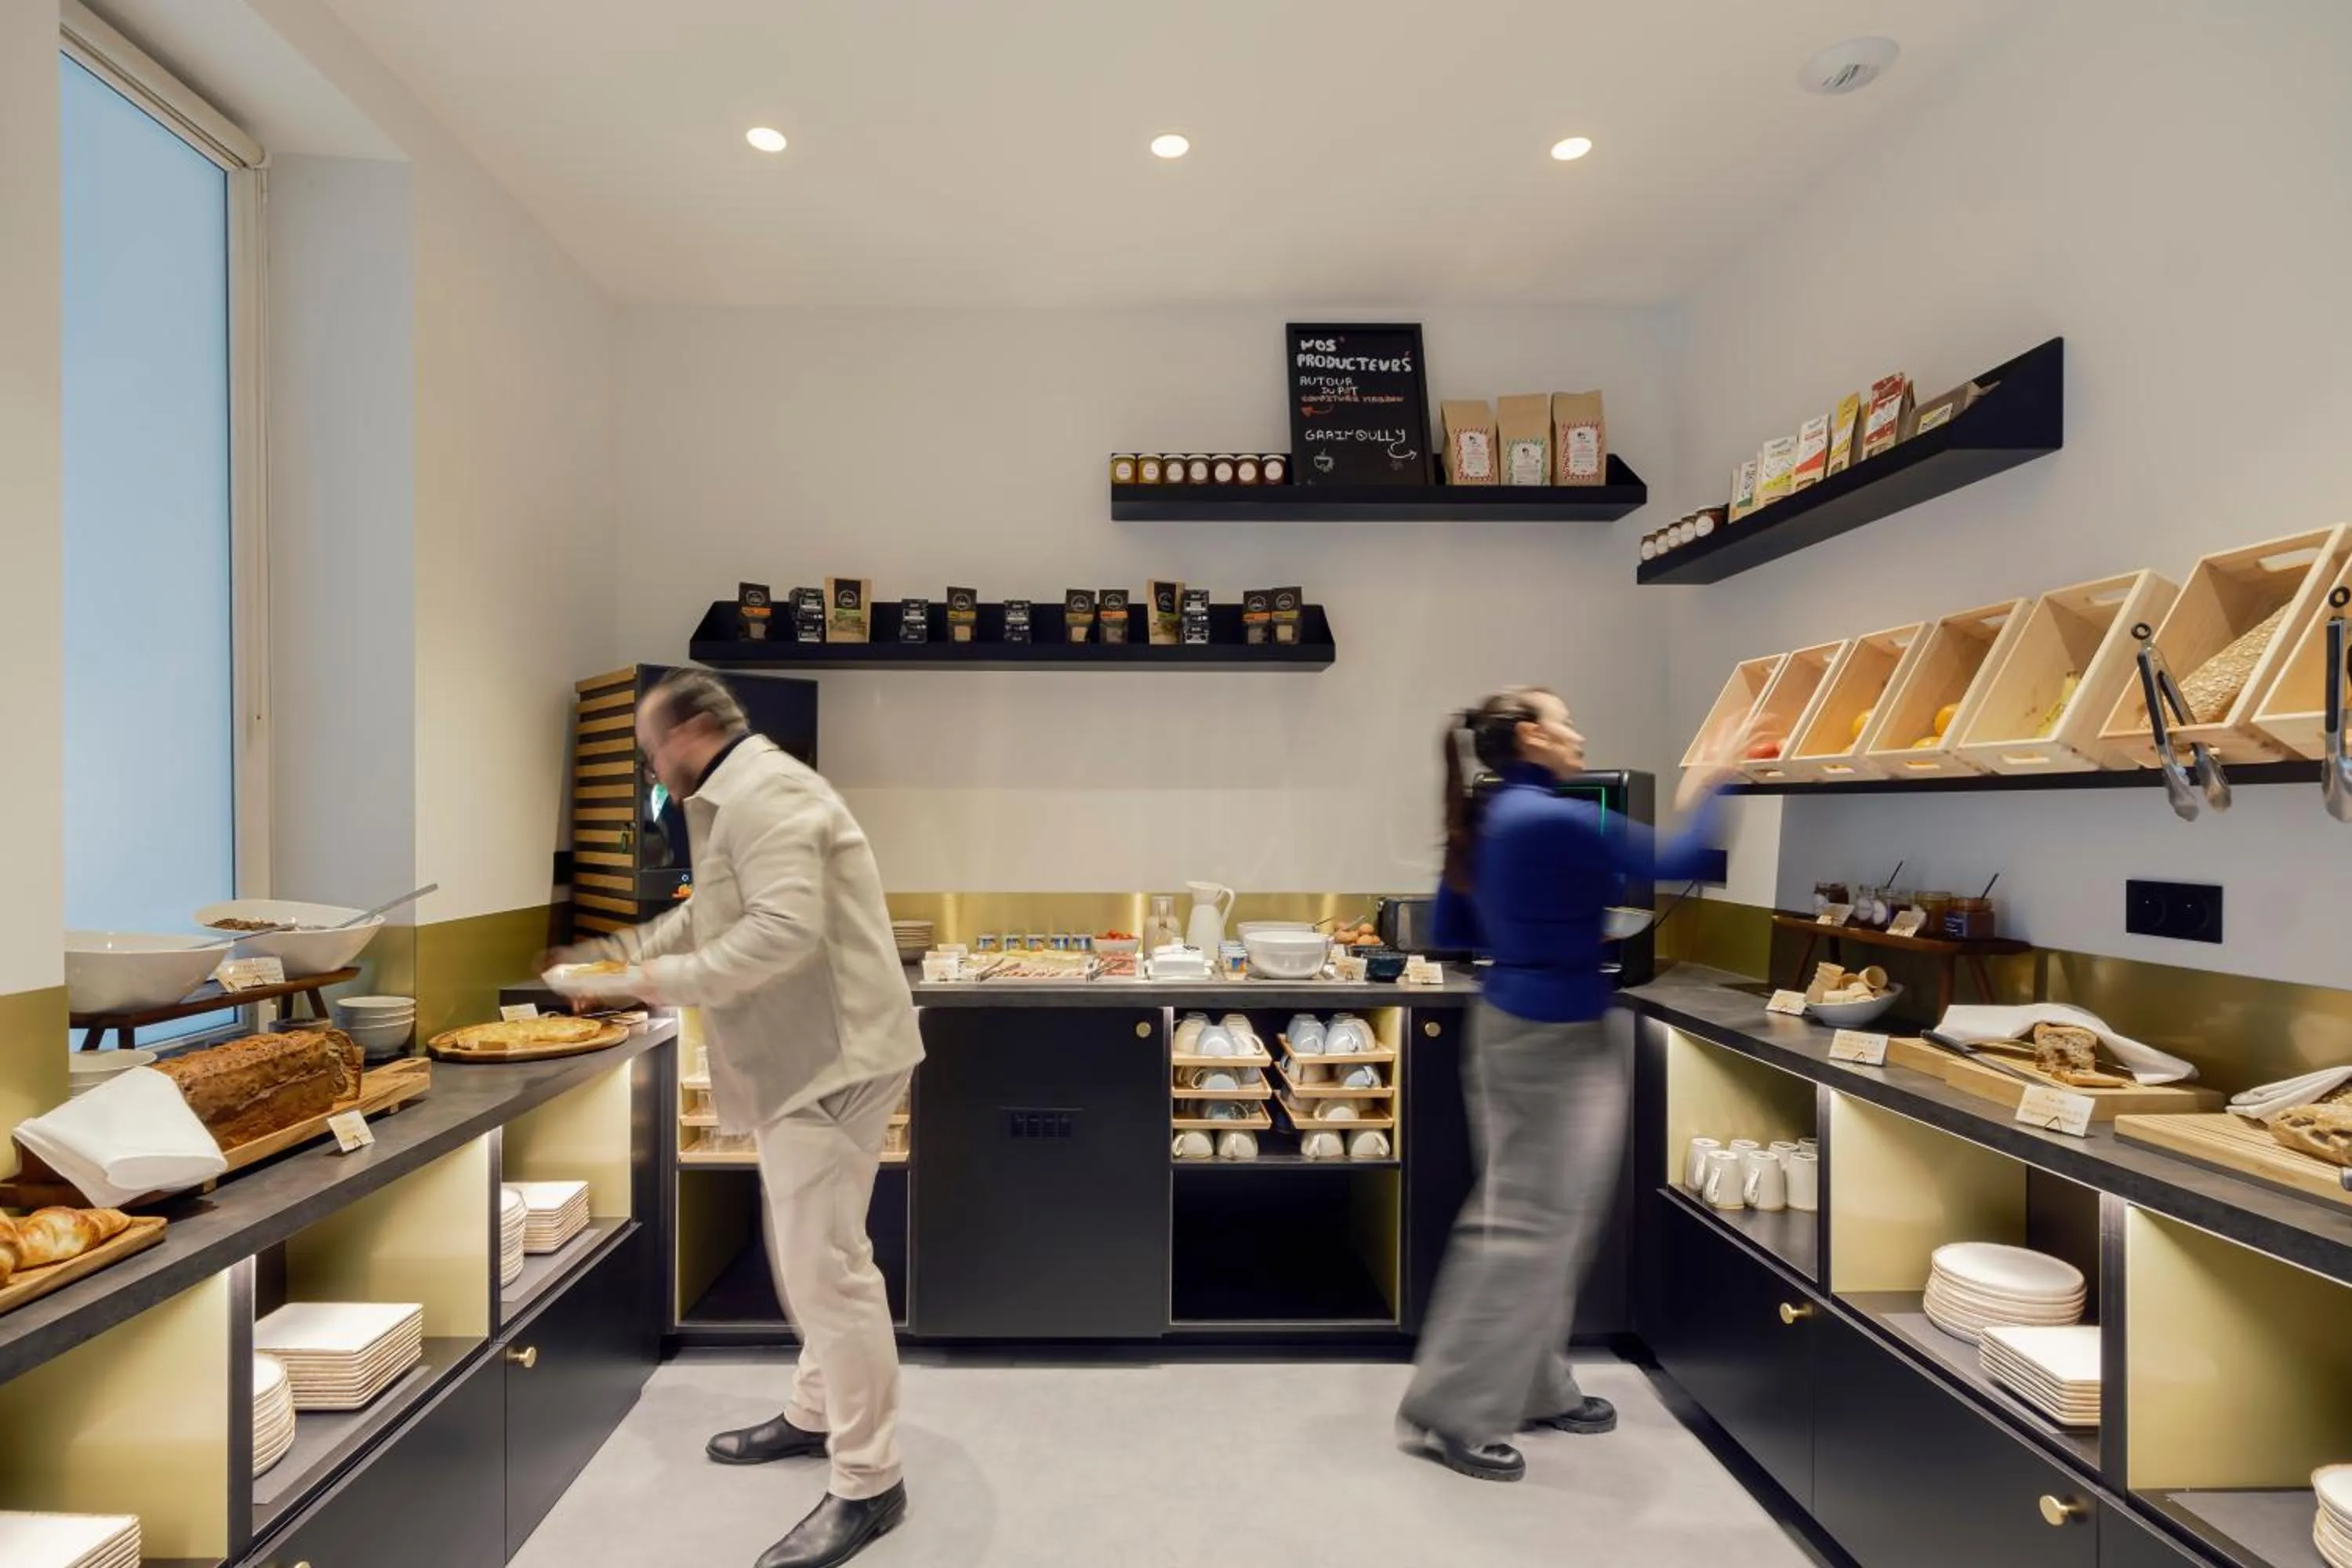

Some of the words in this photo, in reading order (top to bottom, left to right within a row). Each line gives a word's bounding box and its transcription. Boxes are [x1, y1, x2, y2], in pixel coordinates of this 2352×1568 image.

[1300, 339, 1337, 352] NOS
[1296, 353, 1412, 372] PRODUCTEURS
[1299, 376, 1353, 387] AUTOUR
